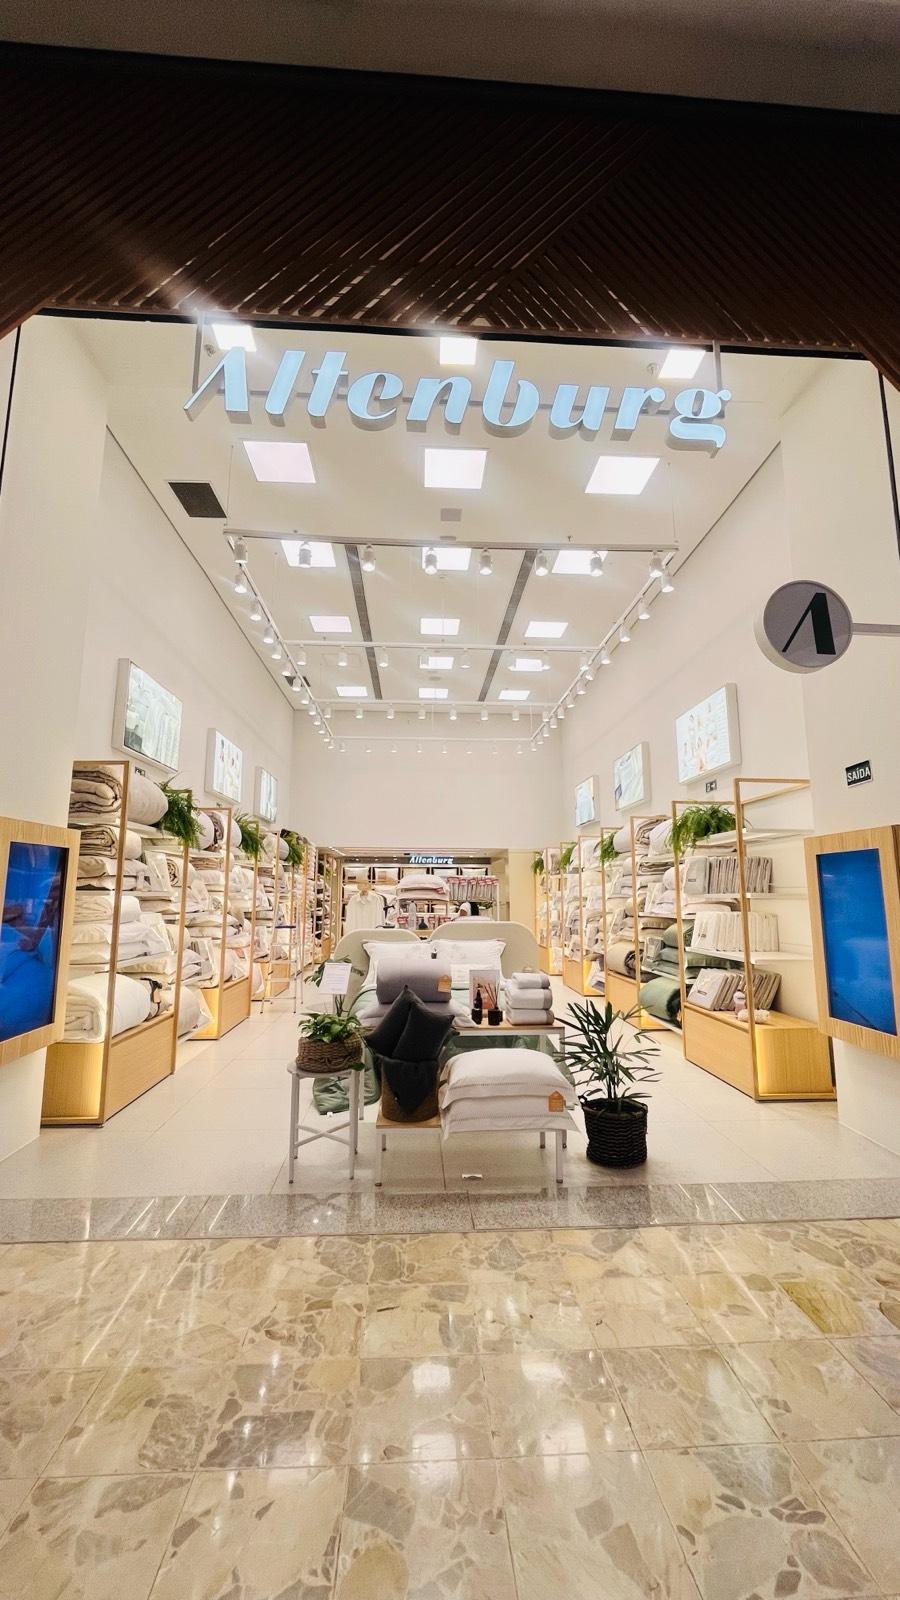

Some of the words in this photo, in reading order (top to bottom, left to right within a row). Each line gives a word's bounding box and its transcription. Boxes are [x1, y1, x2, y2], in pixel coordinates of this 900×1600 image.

[183, 348, 732, 449] Altenburg
[847, 767, 871, 782] SAÍDA
[409, 856, 454, 864] Altenburg
